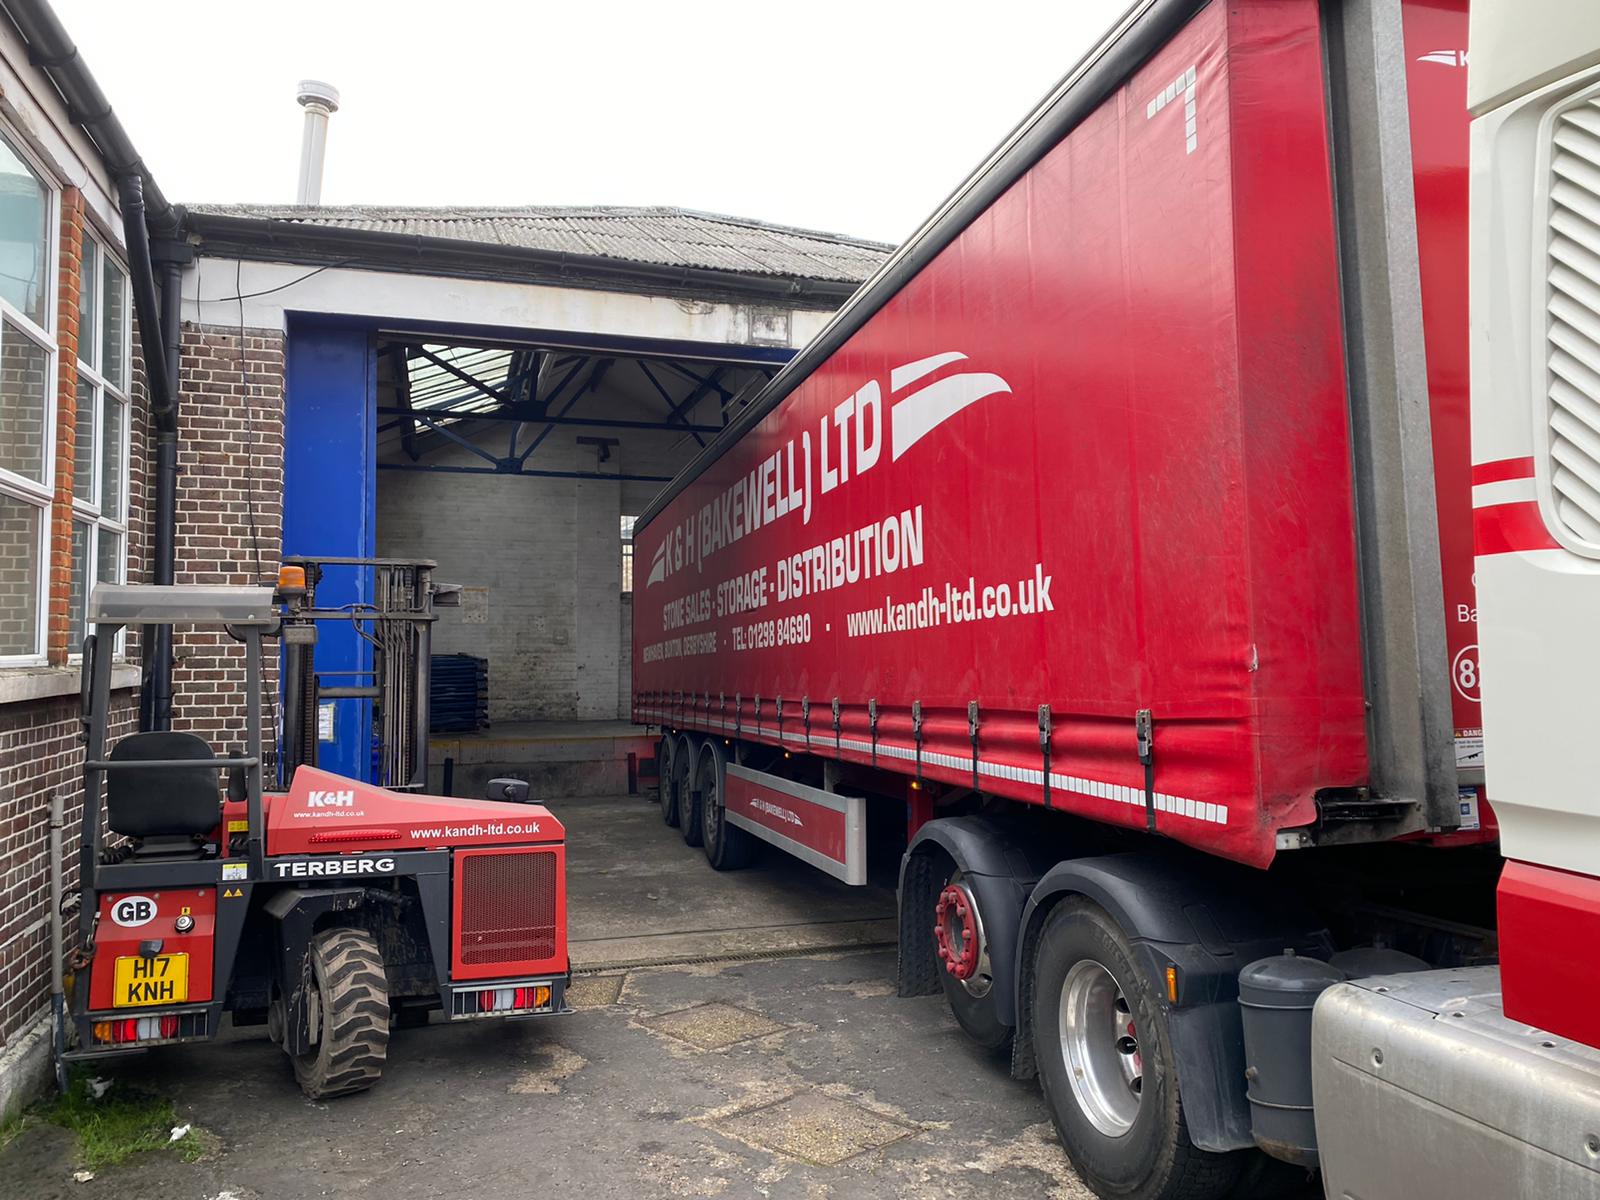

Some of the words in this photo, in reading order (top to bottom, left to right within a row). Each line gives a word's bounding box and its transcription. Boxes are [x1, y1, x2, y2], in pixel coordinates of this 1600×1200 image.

[1147, 64, 1197, 155] 7
[666, 530, 673, 577] K
[675, 525, 682, 571] &
[686, 515, 695, 566] H
[698, 431, 812, 573] (BAKEWELL)
[820, 379, 882, 495] LTD
[663, 597, 684, 631] STONE
[686, 588, 711, 625] SALES
[717, 567, 768, 617] STORAGE
[777, 504, 924, 602] DISTRIBUTION
[732, 627, 747, 650] TEL:
[748, 620, 775, 649] 01298
[777, 613, 811, 646] 84690
[847, 563, 1054, 637] www.kandh-ltd.co.uk
[307, 790, 354, 807] K&H
[410, 822, 540, 839] www.kandh-ltd.co.uk
[273, 858, 395, 877] TERBERG
[118, 901, 151, 922] GB
[134, 958, 170, 979] H17
[128, 980, 174, 1002] KNH
